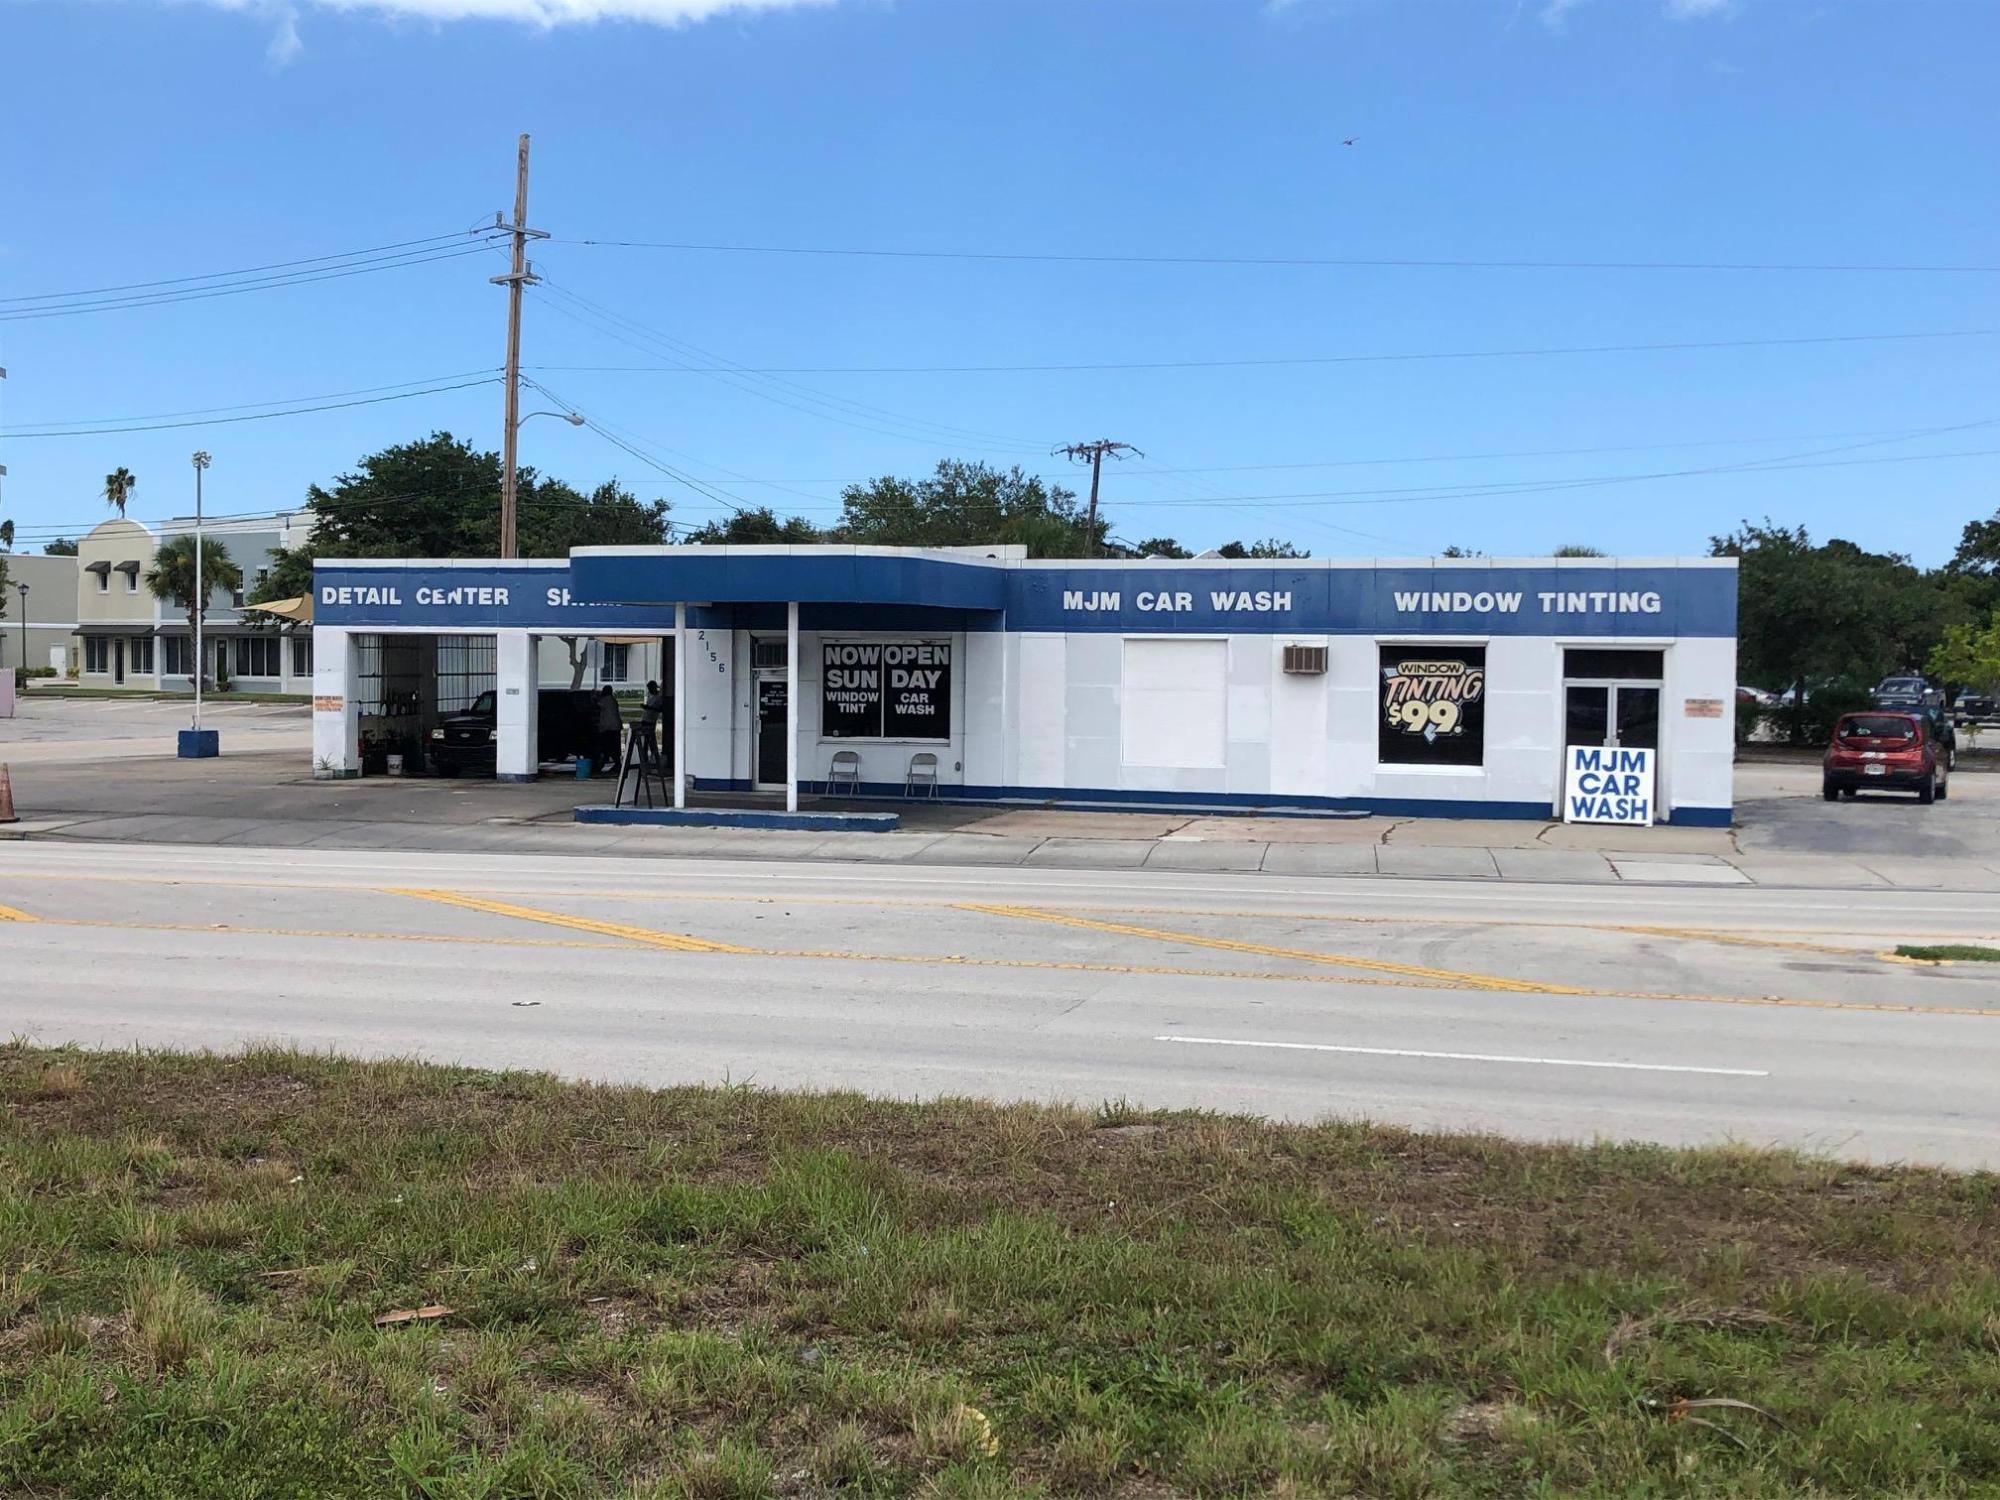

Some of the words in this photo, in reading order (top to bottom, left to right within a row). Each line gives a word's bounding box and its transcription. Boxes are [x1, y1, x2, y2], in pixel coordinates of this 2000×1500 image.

[322, 587, 402, 605] DETAIL
[416, 587, 509, 605] CENTER
[1063, 591, 1120, 610] MJM
[1136, 592, 1192, 611] CAR
[1210, 592, 1291, 611] WASH
[1394, 592, 1522, 612] WINDOW
[1538, 593, 1661, 613] TINTING
[825, 646, 880, 665] NOW
[884, 646, 949, 665] OPEN
[1401, 664, 1460, 673] WINDOW
[827, 669, 878, 688] SUN
[891, 669, 942, 689] DAY
[826, 691, 879, 702] WINDOW
[900, 692, 929, 704] CAR
[1386, 672, 1483, 707] TINTING
[838, 703, 867, 713] TINT
[895, 704, 935, 715] WASH
[1575, 749, 1646, 773] MJM
[1578, 773, 1641, 796] CAR
[1571, 796, 1648, 820] WASH
